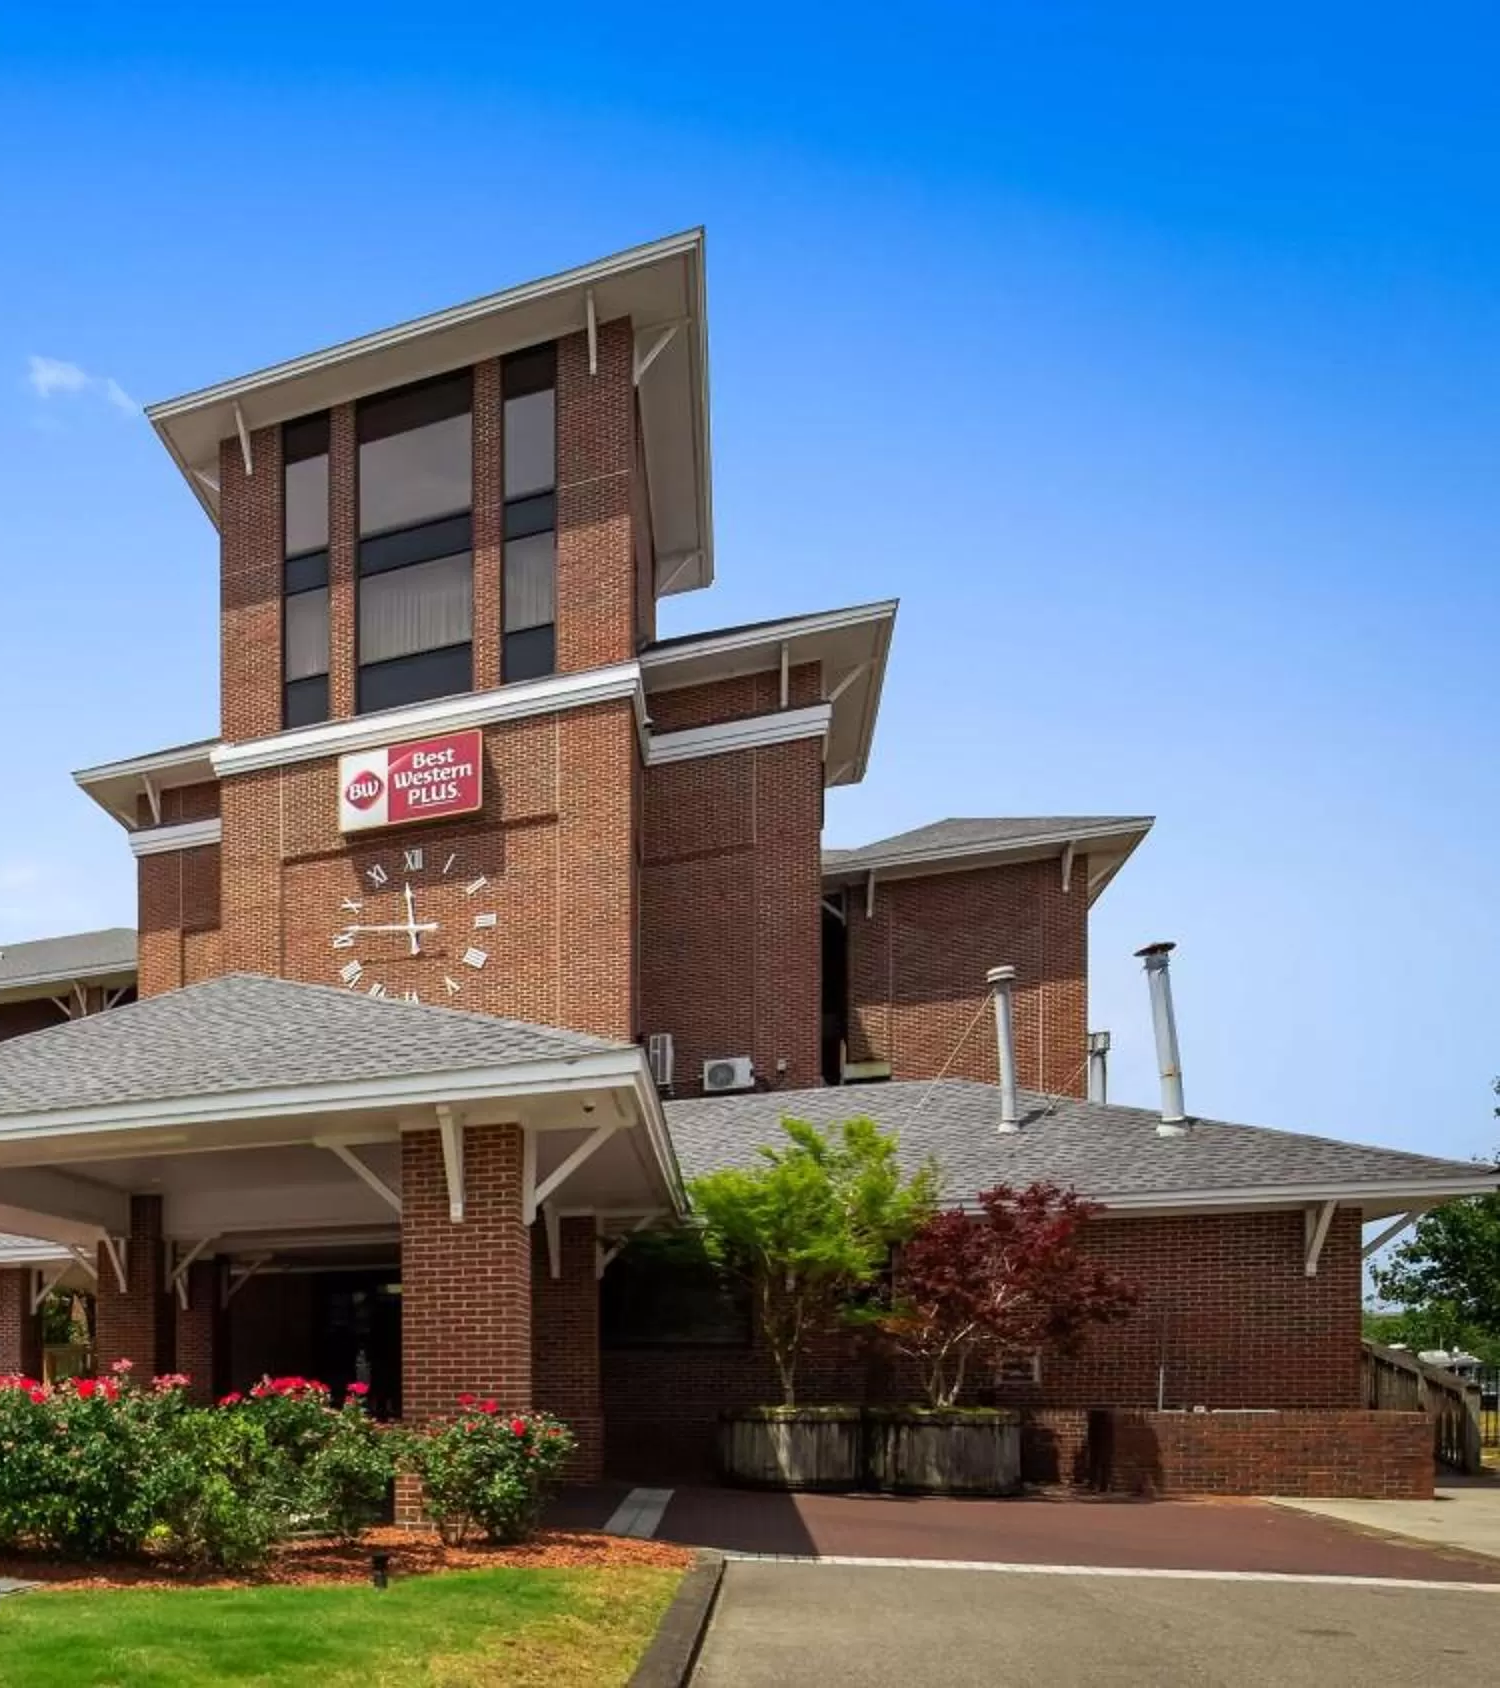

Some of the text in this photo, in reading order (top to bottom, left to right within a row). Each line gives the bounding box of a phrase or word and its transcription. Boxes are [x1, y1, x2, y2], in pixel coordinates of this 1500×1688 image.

[412, 748, 456, 769] Best
[394, 763, 473, 789] Western
[349, 780, 380, 801] BW
[408, 781, 459, 805] PLUS
